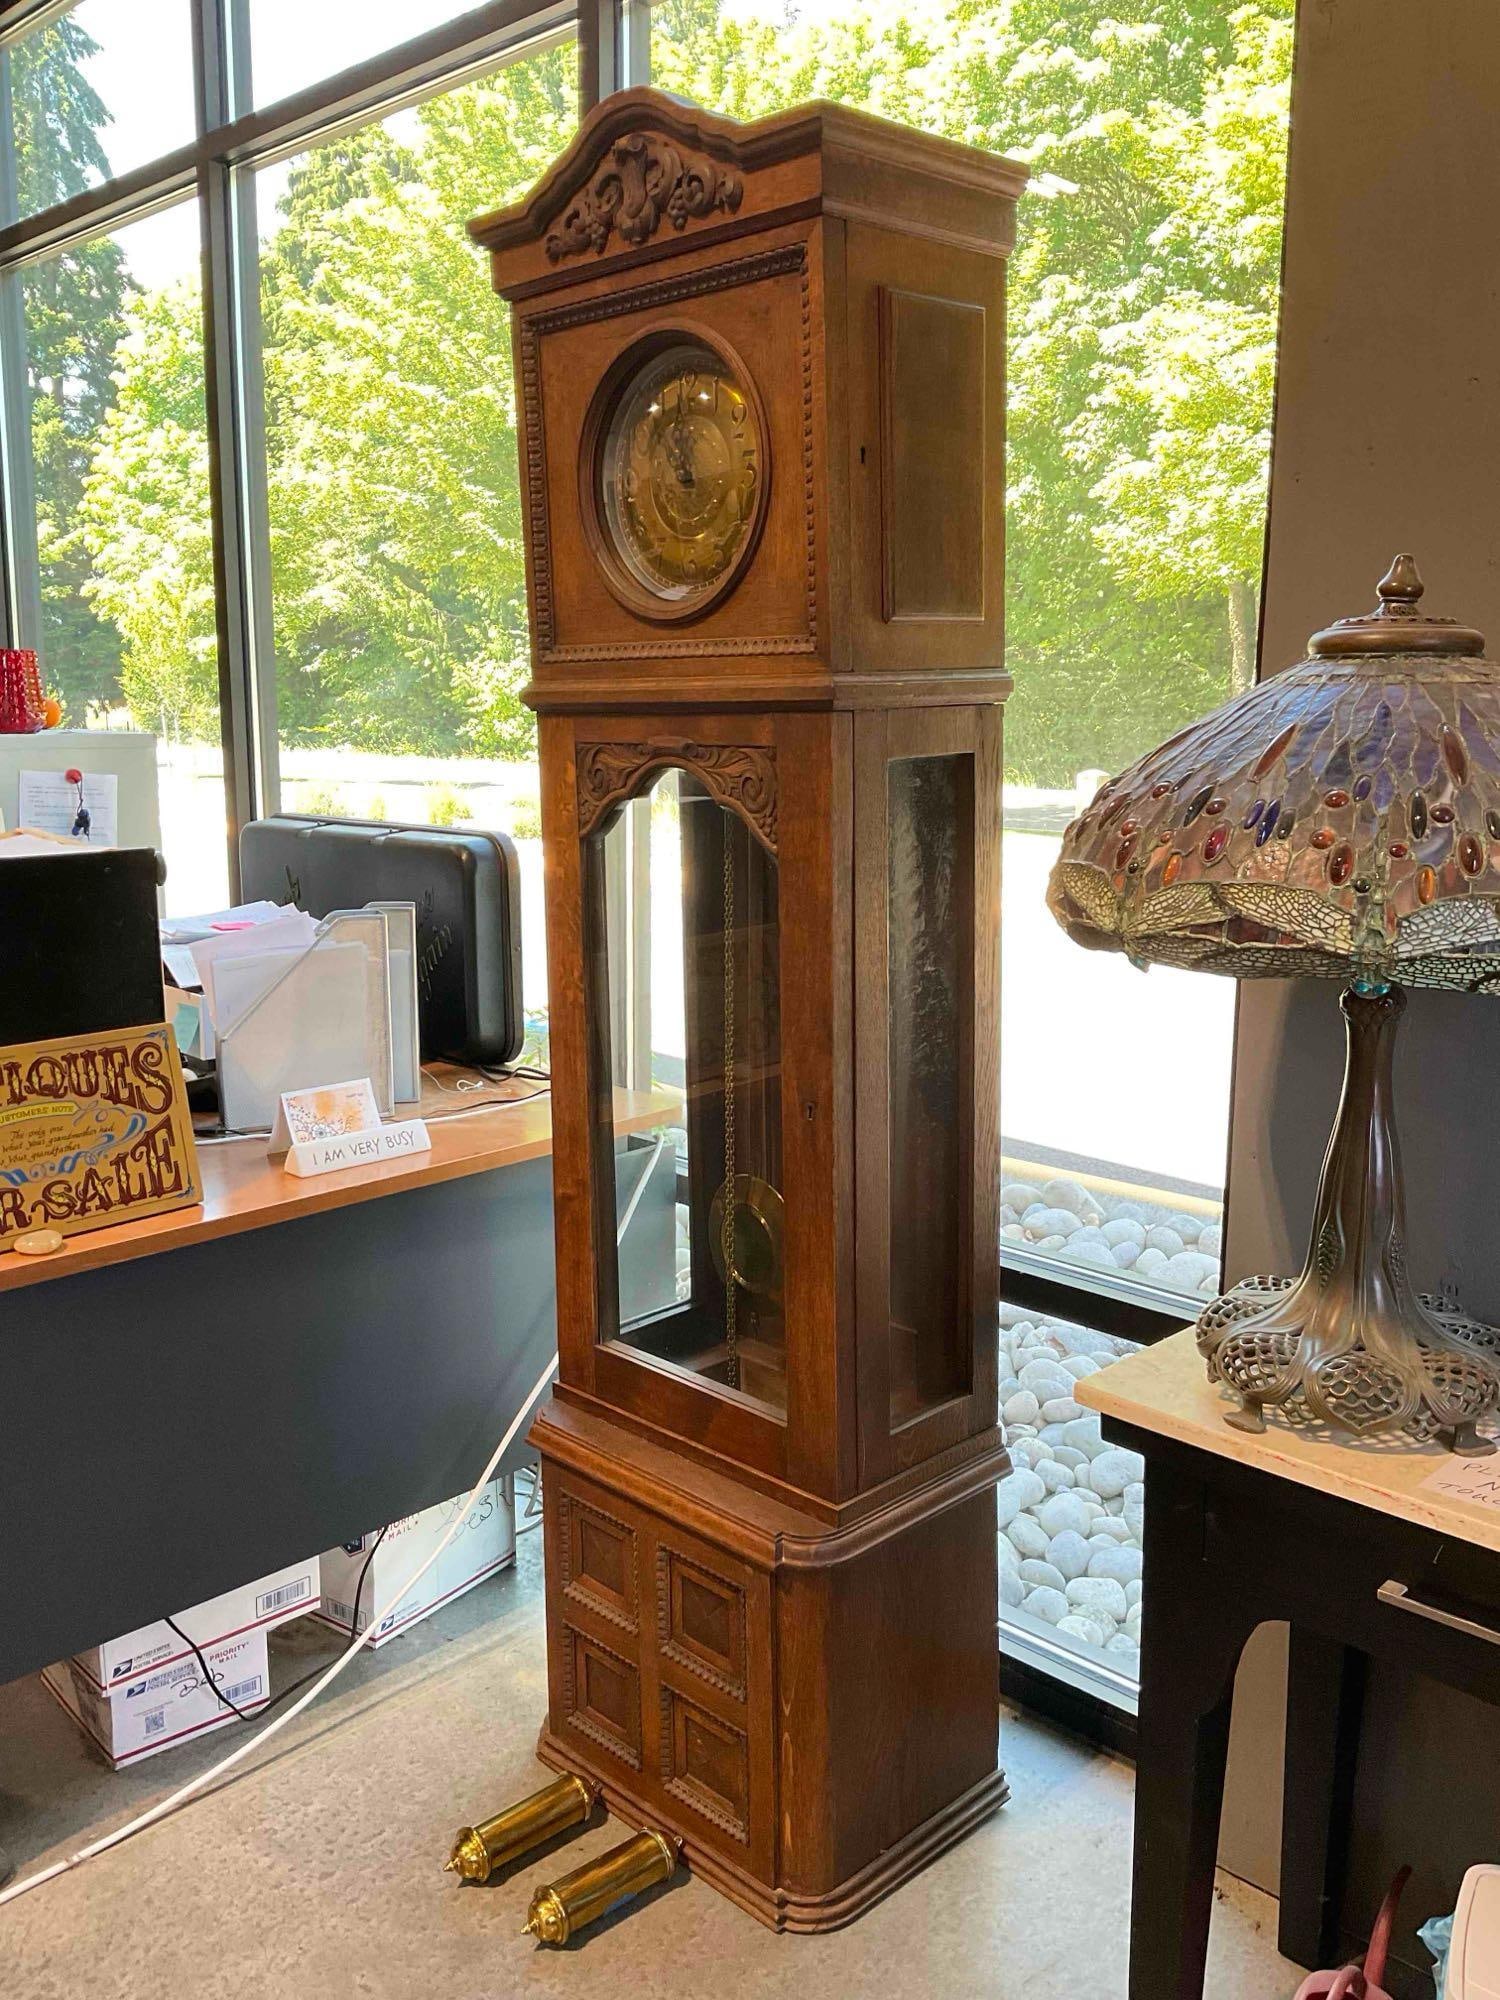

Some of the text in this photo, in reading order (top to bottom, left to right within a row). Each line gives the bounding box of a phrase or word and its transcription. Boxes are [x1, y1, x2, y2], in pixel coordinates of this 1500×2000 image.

[0, 1042, 172, 1114] IQUES
[312, 1130, 415, 1165] I AM VERY BUSY
[31, 1114, 183, 1224] SALE
[1463, 1462, 1500, 1478] PL
[218, 1653, 238, 1664] MAIL
